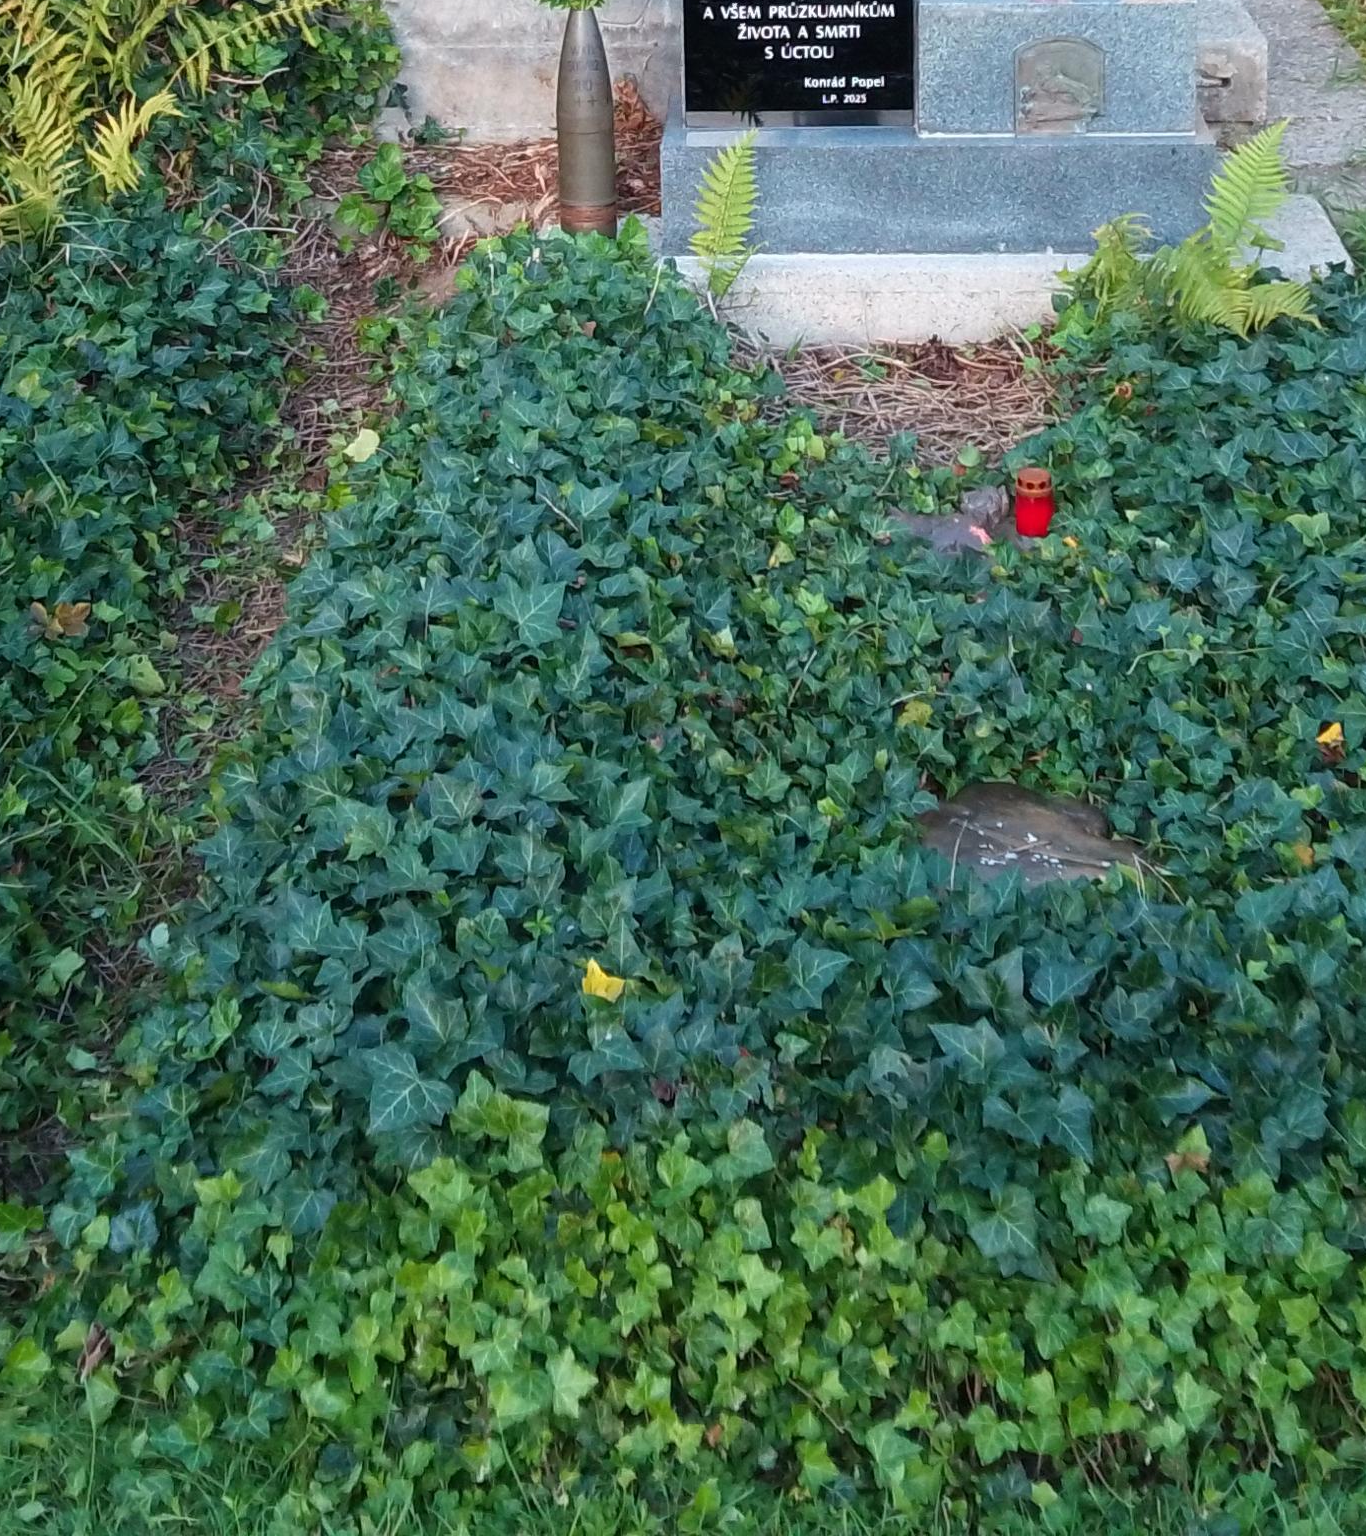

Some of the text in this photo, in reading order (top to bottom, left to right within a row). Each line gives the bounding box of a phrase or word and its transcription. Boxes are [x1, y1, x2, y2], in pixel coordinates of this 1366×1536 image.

[703, 1, 895, 20] A VŠEM PRŮZKUMNÍKŮM
[737, 23, 861, 40] ŽIVOTA A SMRTI
[764, 42, 835, 59] S ÚCTOU
[804, 76, 846, 88] Konrád
[843, 93, 867, 104] 2025
